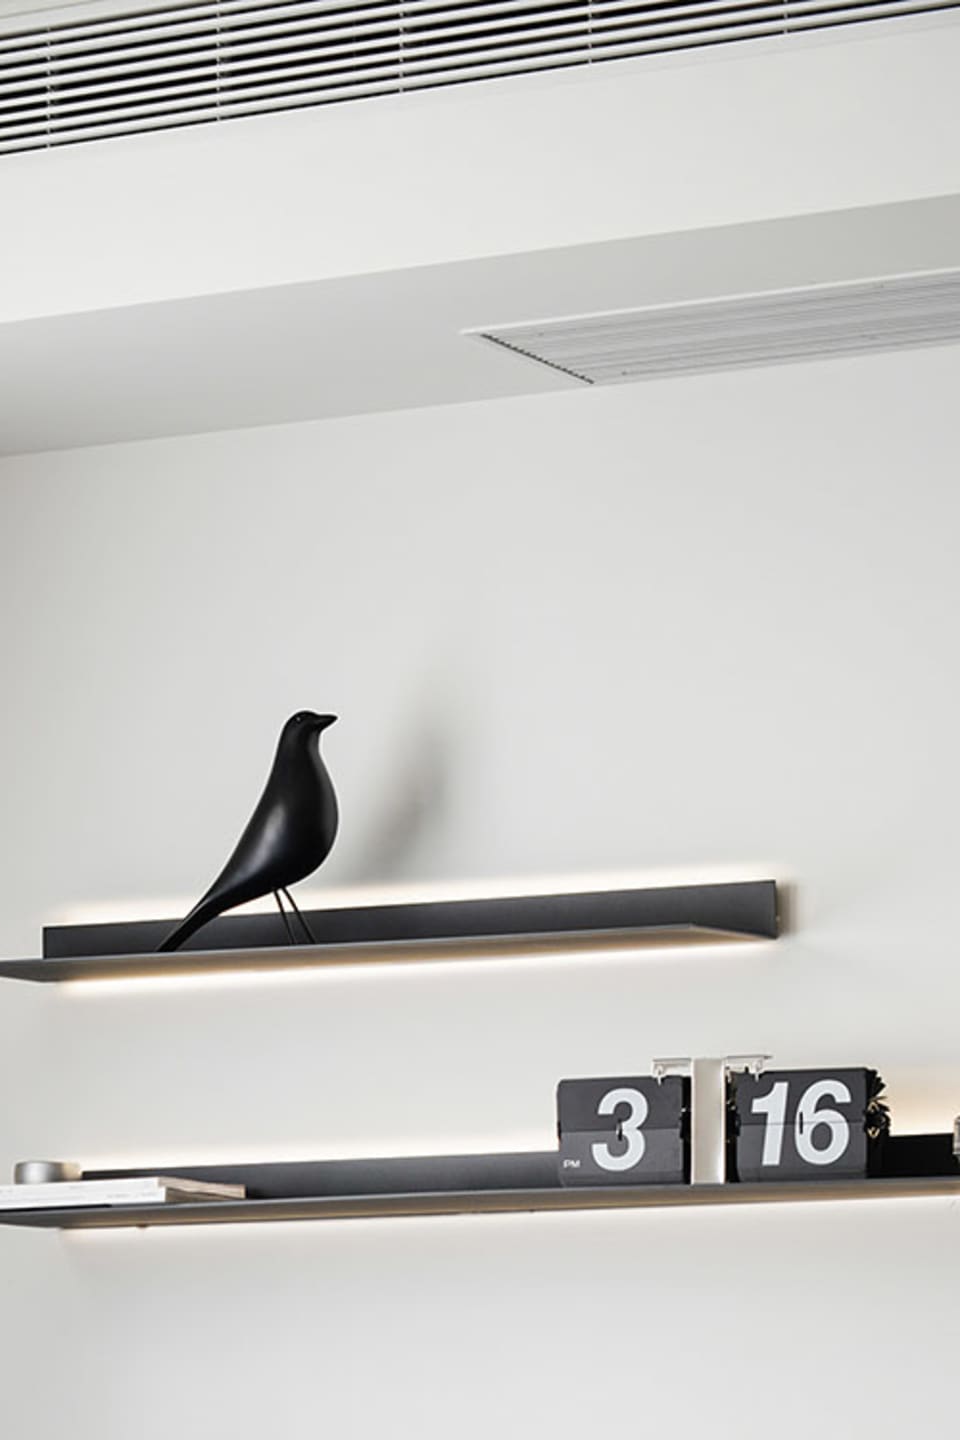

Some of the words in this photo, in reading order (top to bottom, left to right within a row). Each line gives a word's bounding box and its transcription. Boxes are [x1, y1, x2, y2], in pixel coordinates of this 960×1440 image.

[591, 1088, 648, 1171] 3
[751, 1079, 851, 1166] 16
[563, 1159, 581, 1169] PM
